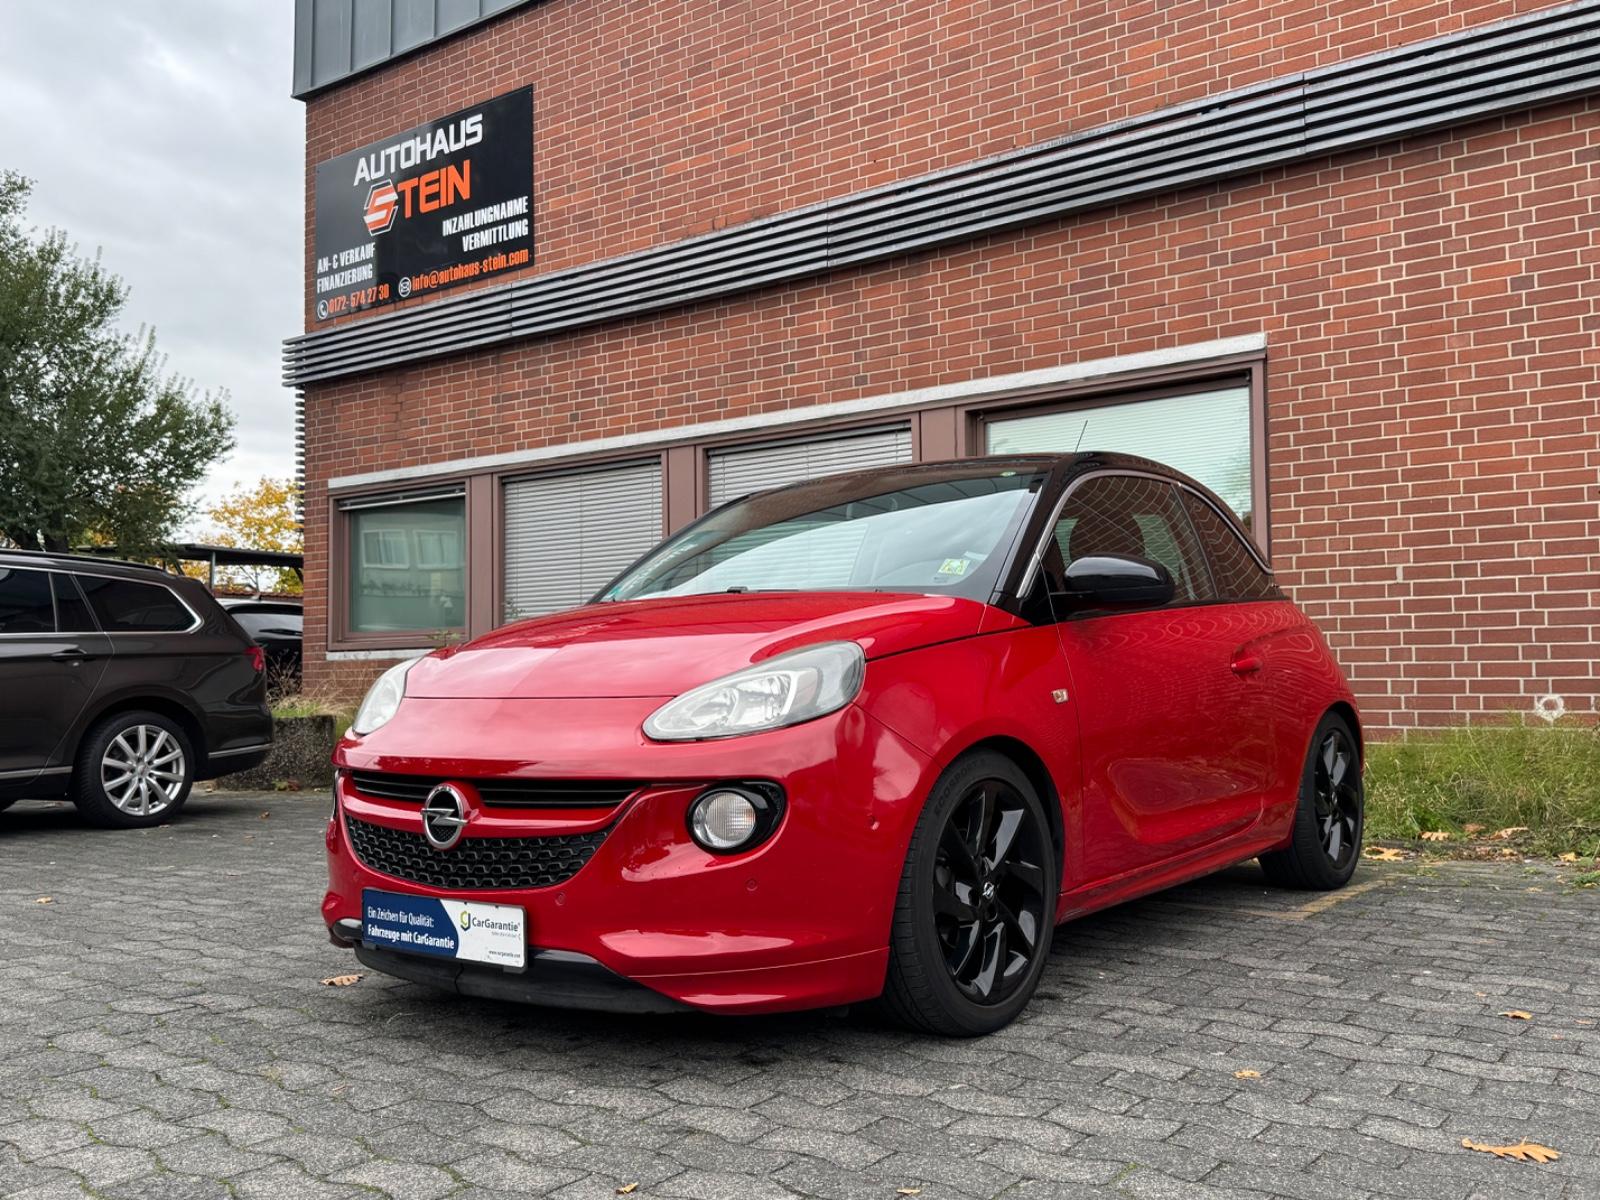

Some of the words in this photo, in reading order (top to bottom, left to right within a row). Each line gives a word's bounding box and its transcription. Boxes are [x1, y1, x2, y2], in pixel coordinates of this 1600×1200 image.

[353, 113, 484, 186] AUTOHAUS
[363, 159, 471, 233] STEIN
[442, 196, 529, 237] INZAHLUNGNAHME
[462, 218, 529, 252] VERMITTLUNG
[317, 257, 332, 274] AN-
[332, 254, 339, 269] &
[339, 242, 376, 267] VERKAUF
[412, 249, 529, 291] info@autohaus-stein.com
[316, 263, 373, 294] FINANZIERUNG
[367, 286, 377, 303] 27
[378, 284, 390, 300] 30
[367, 906, 377, 919] Ein
[377, 907, 399, 922] Zeichen
[399, 911, 408, 924] für
[408, 912, 435, 928] Qualität:
[472, 916, 519, 932] CarGarantie
[367, 923, 400, 943] Fahrzeuge
[400, 930, 412, 943] mit
[413, 931, 455, 949] CarGarantie
